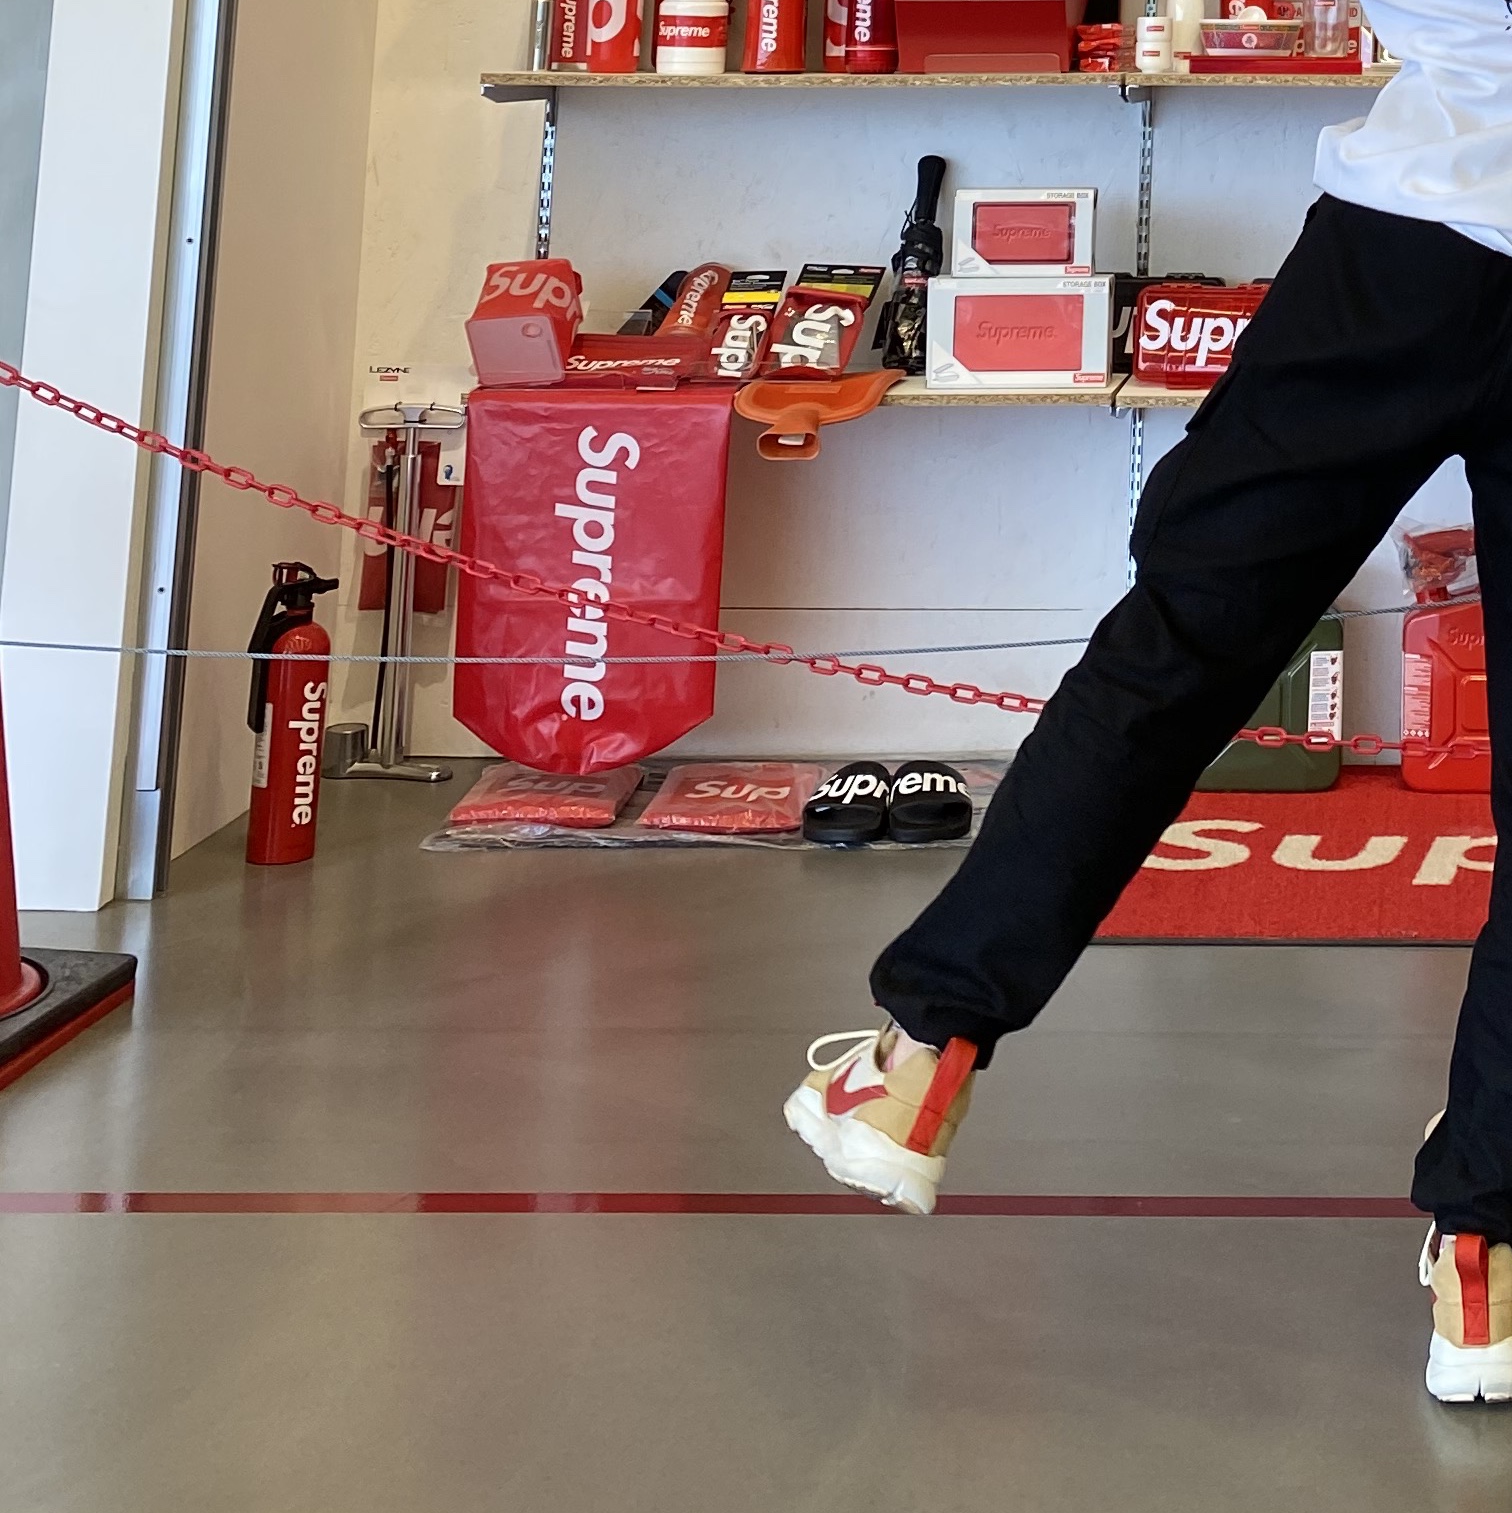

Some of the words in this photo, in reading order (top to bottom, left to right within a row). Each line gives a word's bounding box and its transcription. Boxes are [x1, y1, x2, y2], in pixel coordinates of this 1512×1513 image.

[659, 21, 711, 41] Supreme
[369, 365, 412, 374] LEZYNE
[565, 355, 681, 371] Supreme
[554, 424, 641, 722] Supreme
[287, 680, 328, 823] Supreme
